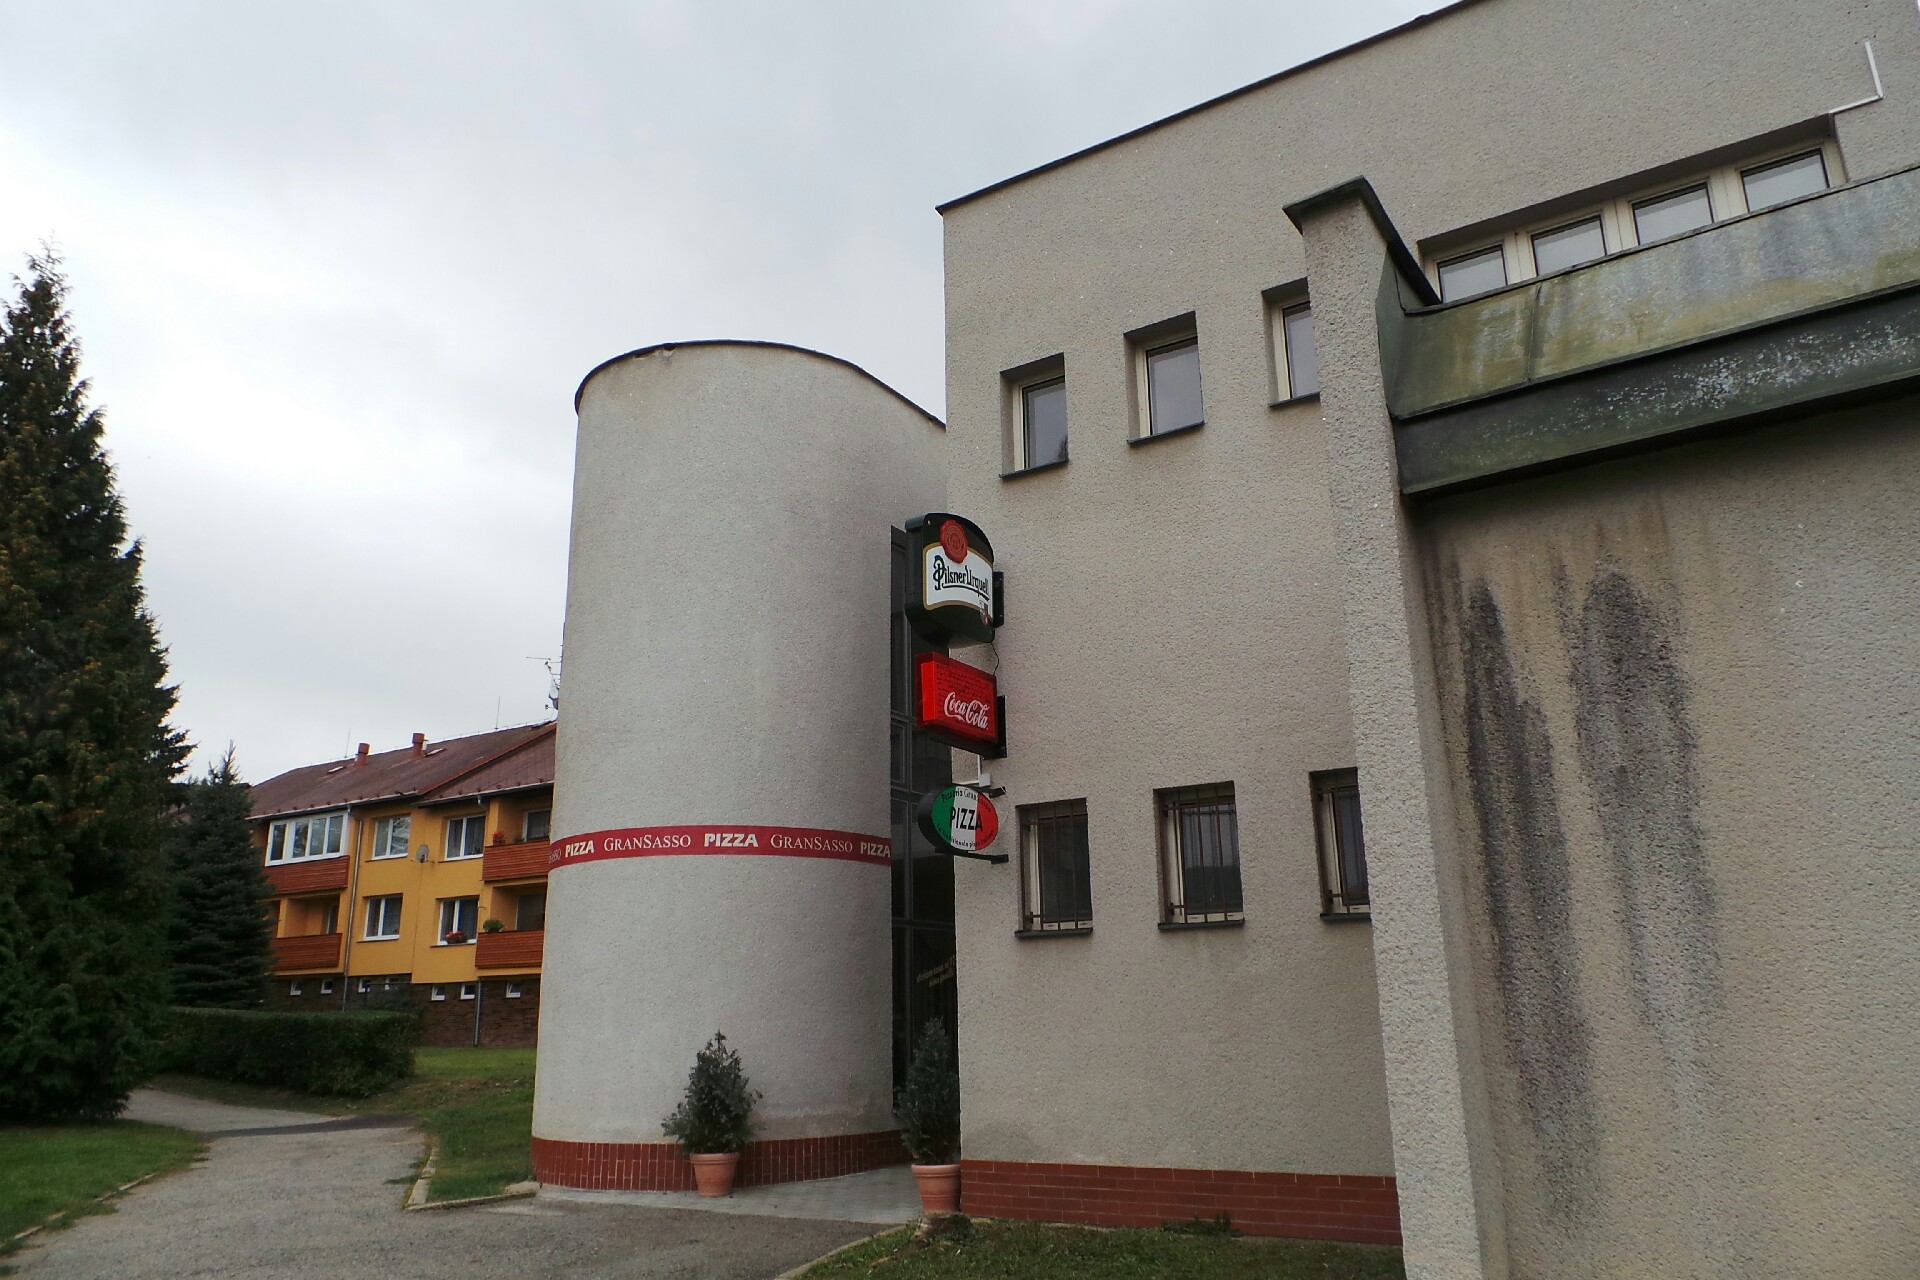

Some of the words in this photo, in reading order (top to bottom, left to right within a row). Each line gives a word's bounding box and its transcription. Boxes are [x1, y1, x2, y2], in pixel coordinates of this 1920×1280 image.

[933, 555, 966, 590] Pilsner
[965, 565, 989, 597] Urquell
[950, 806, 983, 831] PIZZA
[565, 840, 595, 858] PIZZA
[704, 833, 758, 848] PIZZA
[860, 841, 891, 858] PIZZA
